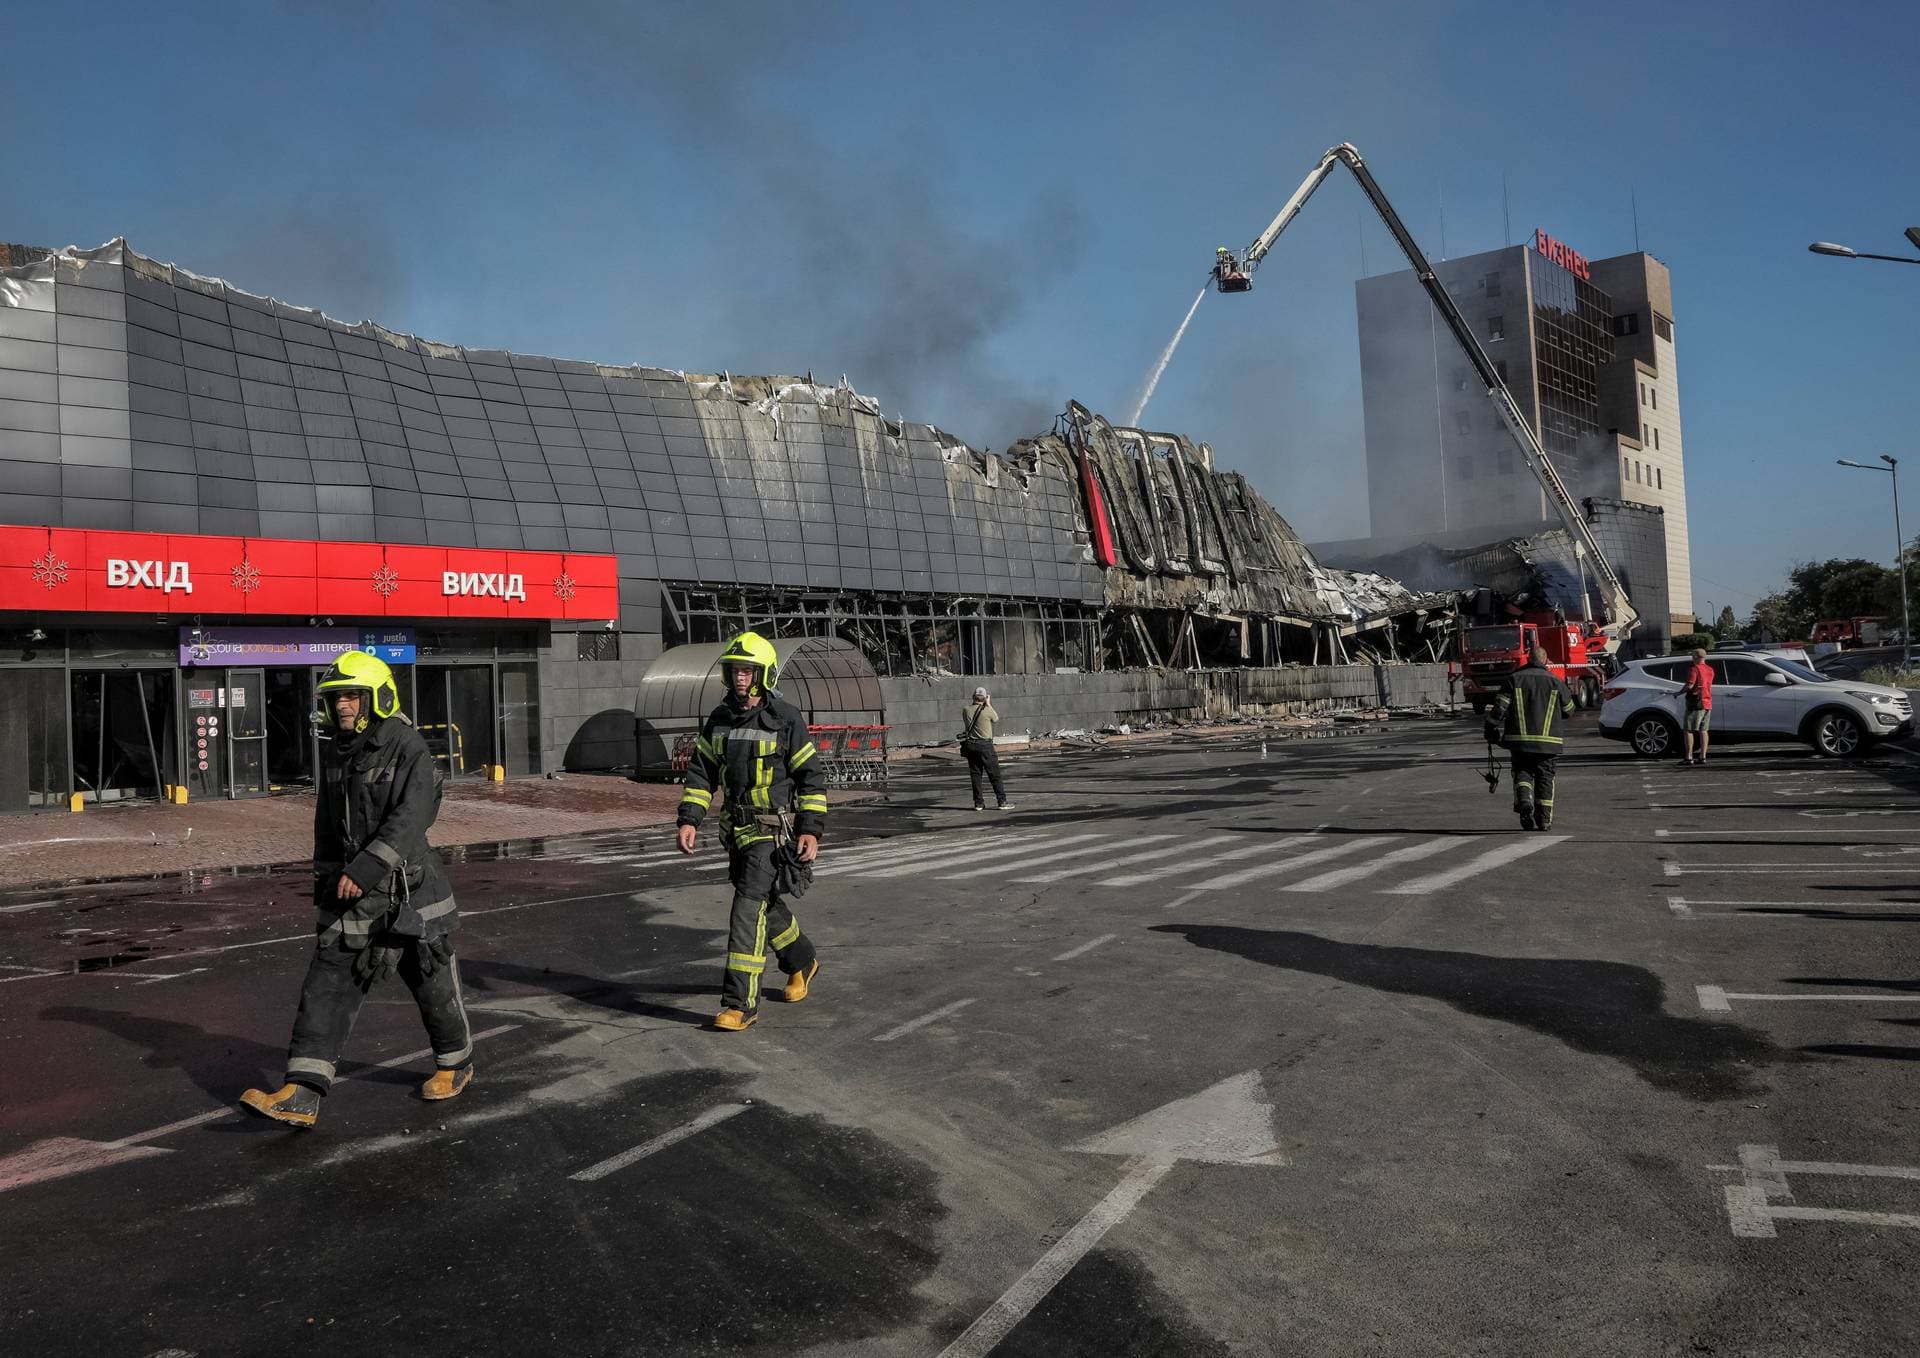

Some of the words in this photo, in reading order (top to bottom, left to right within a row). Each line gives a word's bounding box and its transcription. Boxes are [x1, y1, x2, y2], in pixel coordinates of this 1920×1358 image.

[1536, 226, 1590, 280] БИЗНЕС
[107, 559, 193, 594] ВХІД
[443, 571, 526, 602] ВИХІД
[309, 642, 353, 653] аптека
